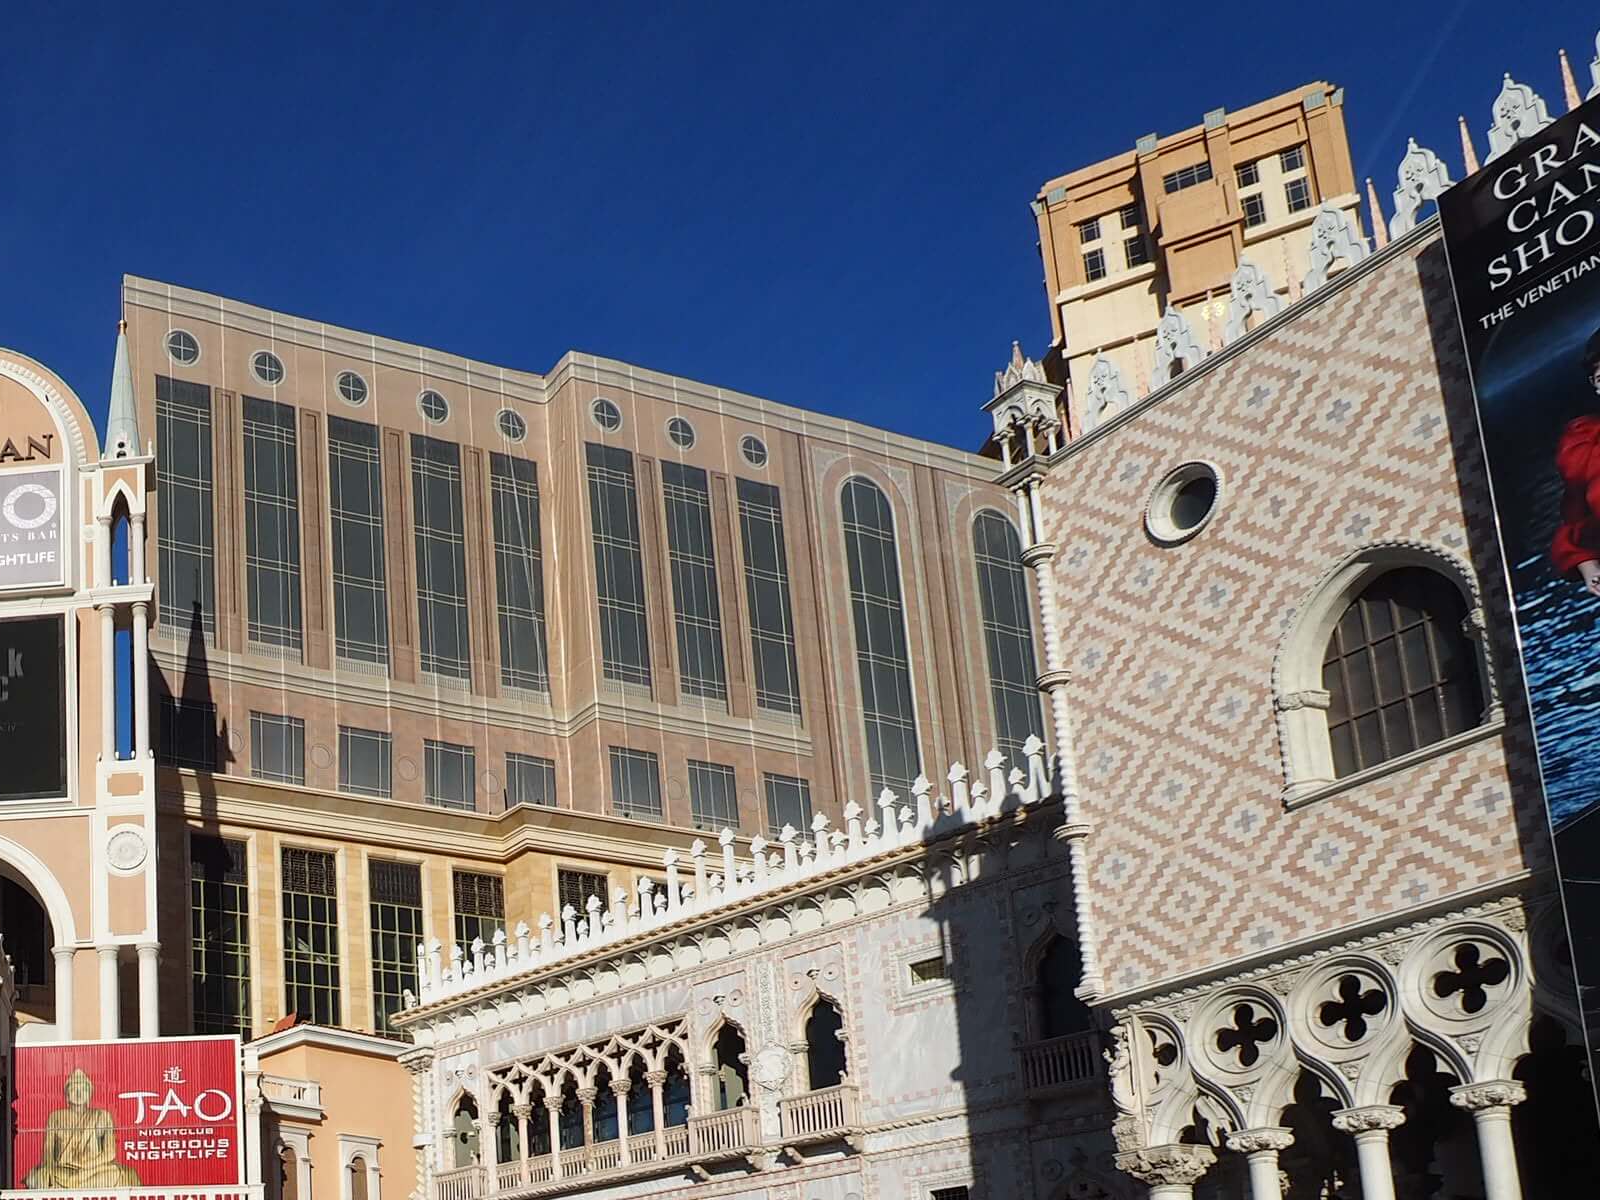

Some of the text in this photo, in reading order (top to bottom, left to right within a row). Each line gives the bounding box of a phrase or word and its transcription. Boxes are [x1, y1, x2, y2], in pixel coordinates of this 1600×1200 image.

[1492, 121, 1600, 201] GRA
[1487, 209, 1595, 292] SHO
[1479, 301, 1514, 330] THE
[27, 529, 57, 541] BAR
[163, 1065, 187, 1084] 道
[118, 1087, 233, 1126] TAO
[139, 1127, 214, 1137] NIGHTCLUB
[124, 1138, 230, 1151] RELIGIOUS
[126, 1149, 228, 1161] NIGHTLIFE
